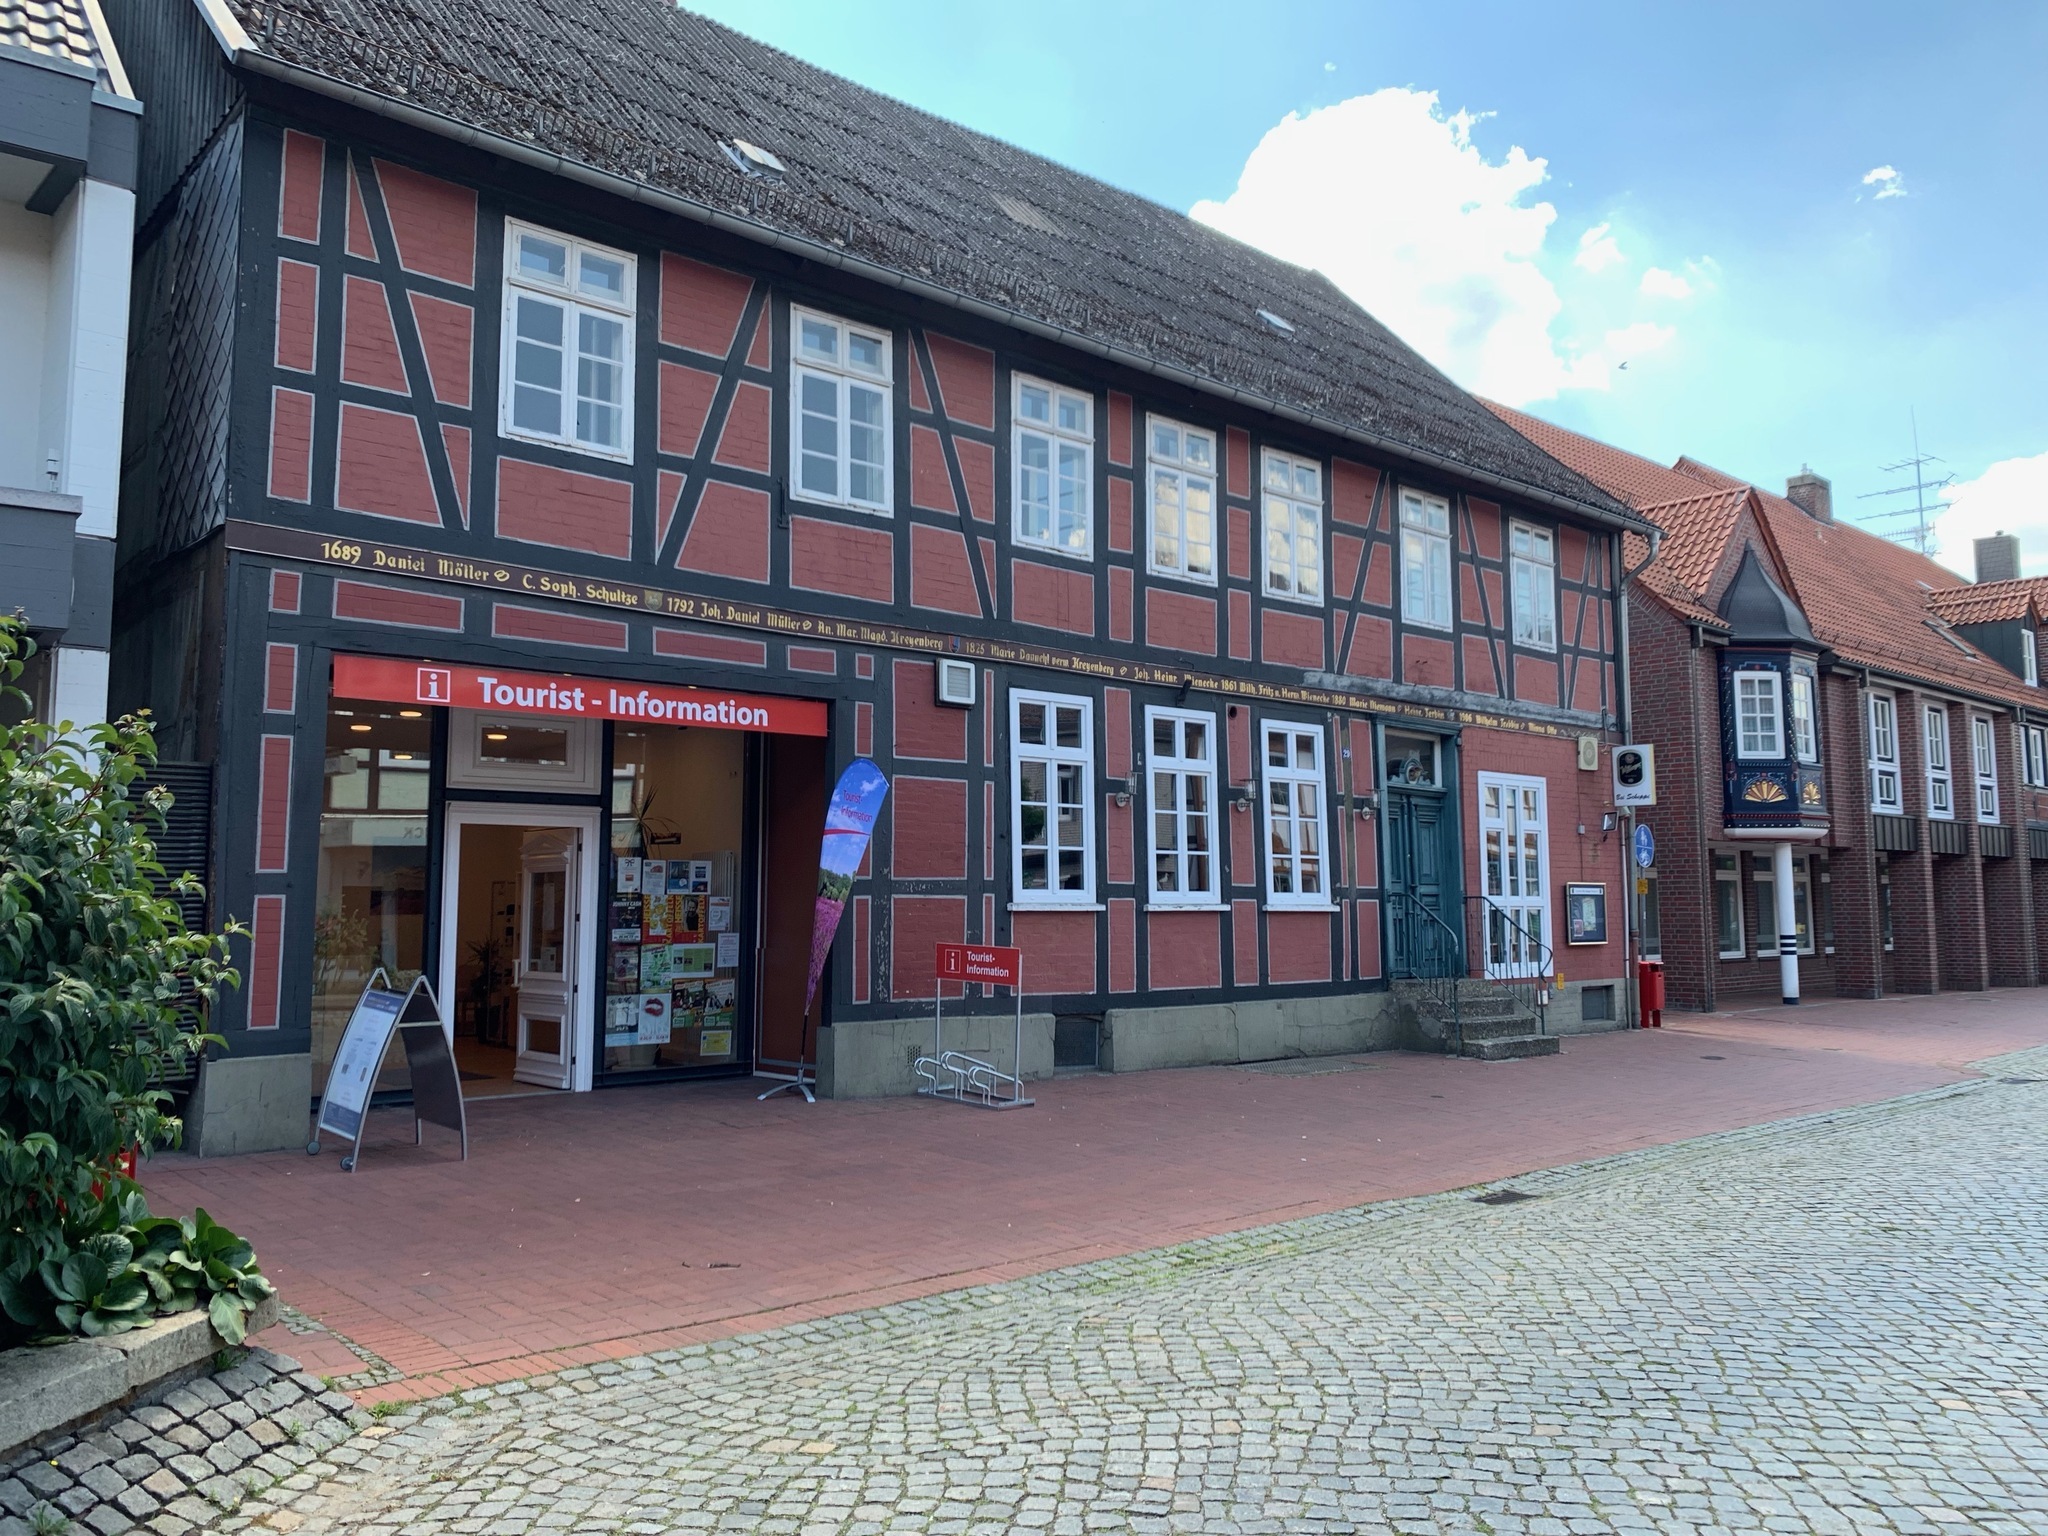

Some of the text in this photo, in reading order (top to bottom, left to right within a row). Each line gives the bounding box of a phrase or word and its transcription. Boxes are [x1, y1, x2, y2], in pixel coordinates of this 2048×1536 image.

[321, 540, 361, 564] 1689
[373, 550, 425, 572] Daniel
[438, 559, 489, 581] Möller
[523, 573, 536, 590] C.
[540, 577, 580, 598] Soph.
[586, 584, 638, 605] Schultze
[667, 597, 694, 614] 1792
[701, 602, 723, 619] Joh.
[726, 606, 760, 624] Daniel
[990, 644, 1015, 659] Marie
[477, 675, 584, 711] Tourist
[610, 688, 768, 727] Information
[966, 951, 995, 963] Tourist-
[966, 964, 1009, 977] Information
